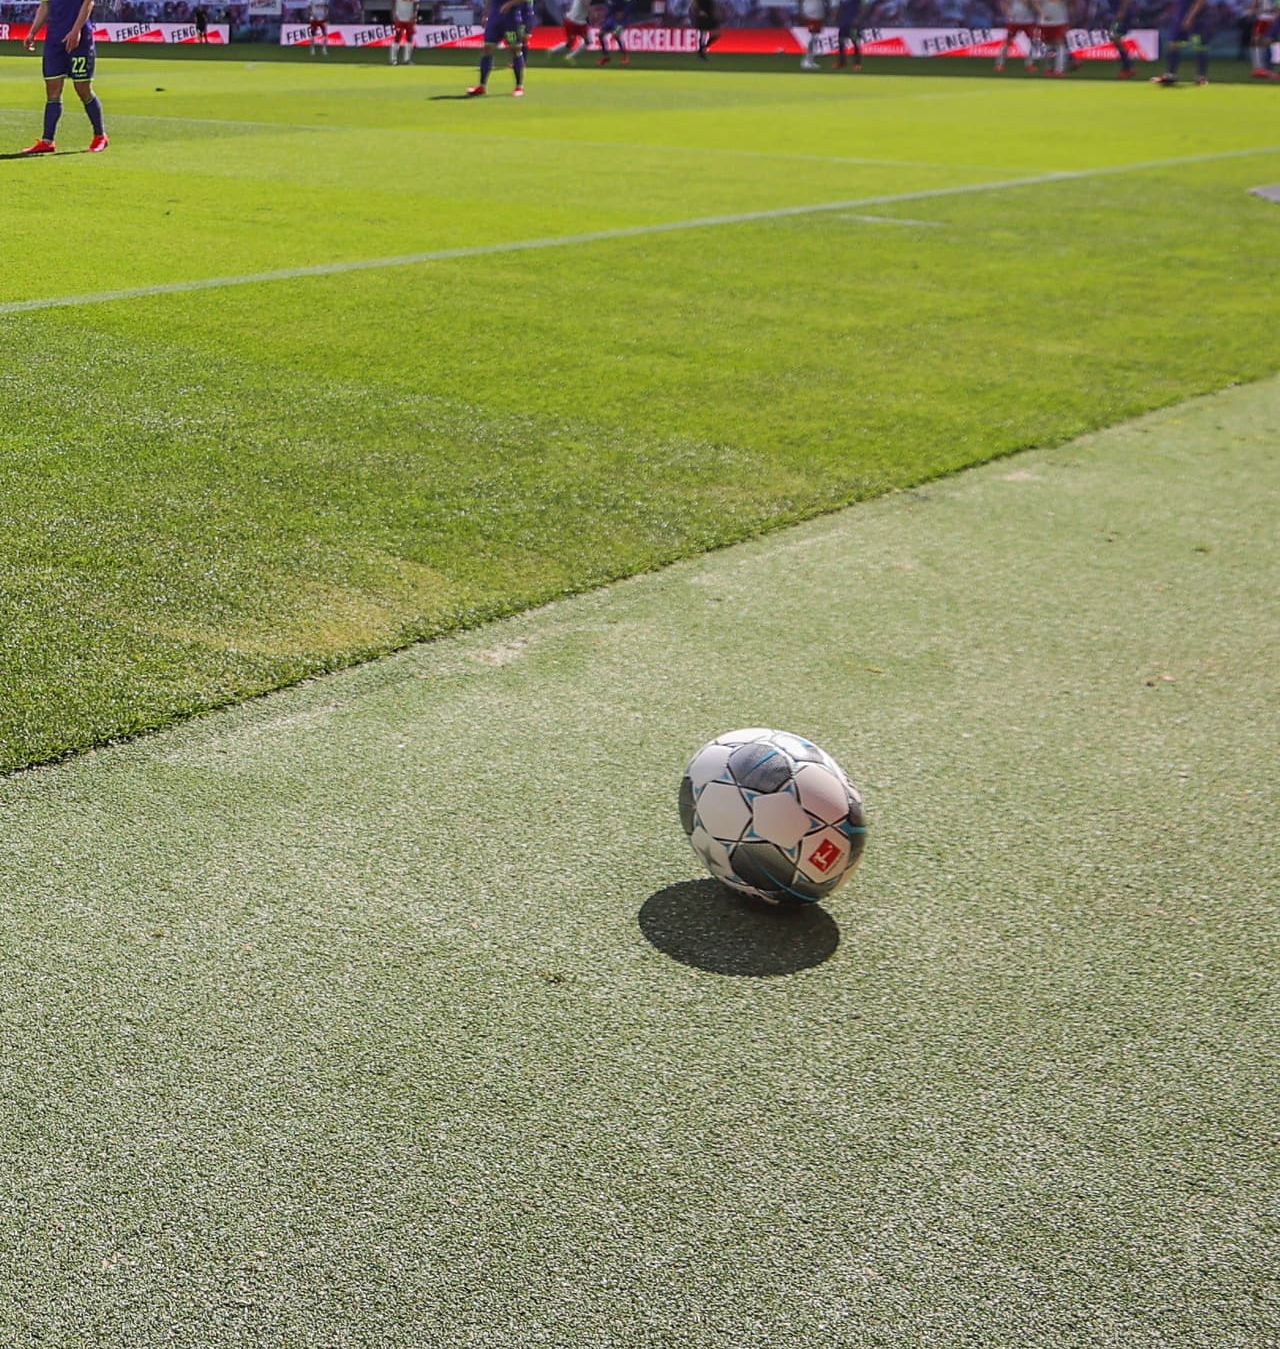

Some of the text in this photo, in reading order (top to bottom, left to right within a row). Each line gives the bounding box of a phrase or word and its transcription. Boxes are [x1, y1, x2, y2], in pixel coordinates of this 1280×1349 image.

[116, 23, 152, 40] FENGER
[171, 25, 197, 39] FENG
[286, 27, 319, 43] FENG
[426, 25, 473, 45] FENGER
[923, 28, 994, 52] FENGER
[71, 56, 88, 73] 22
